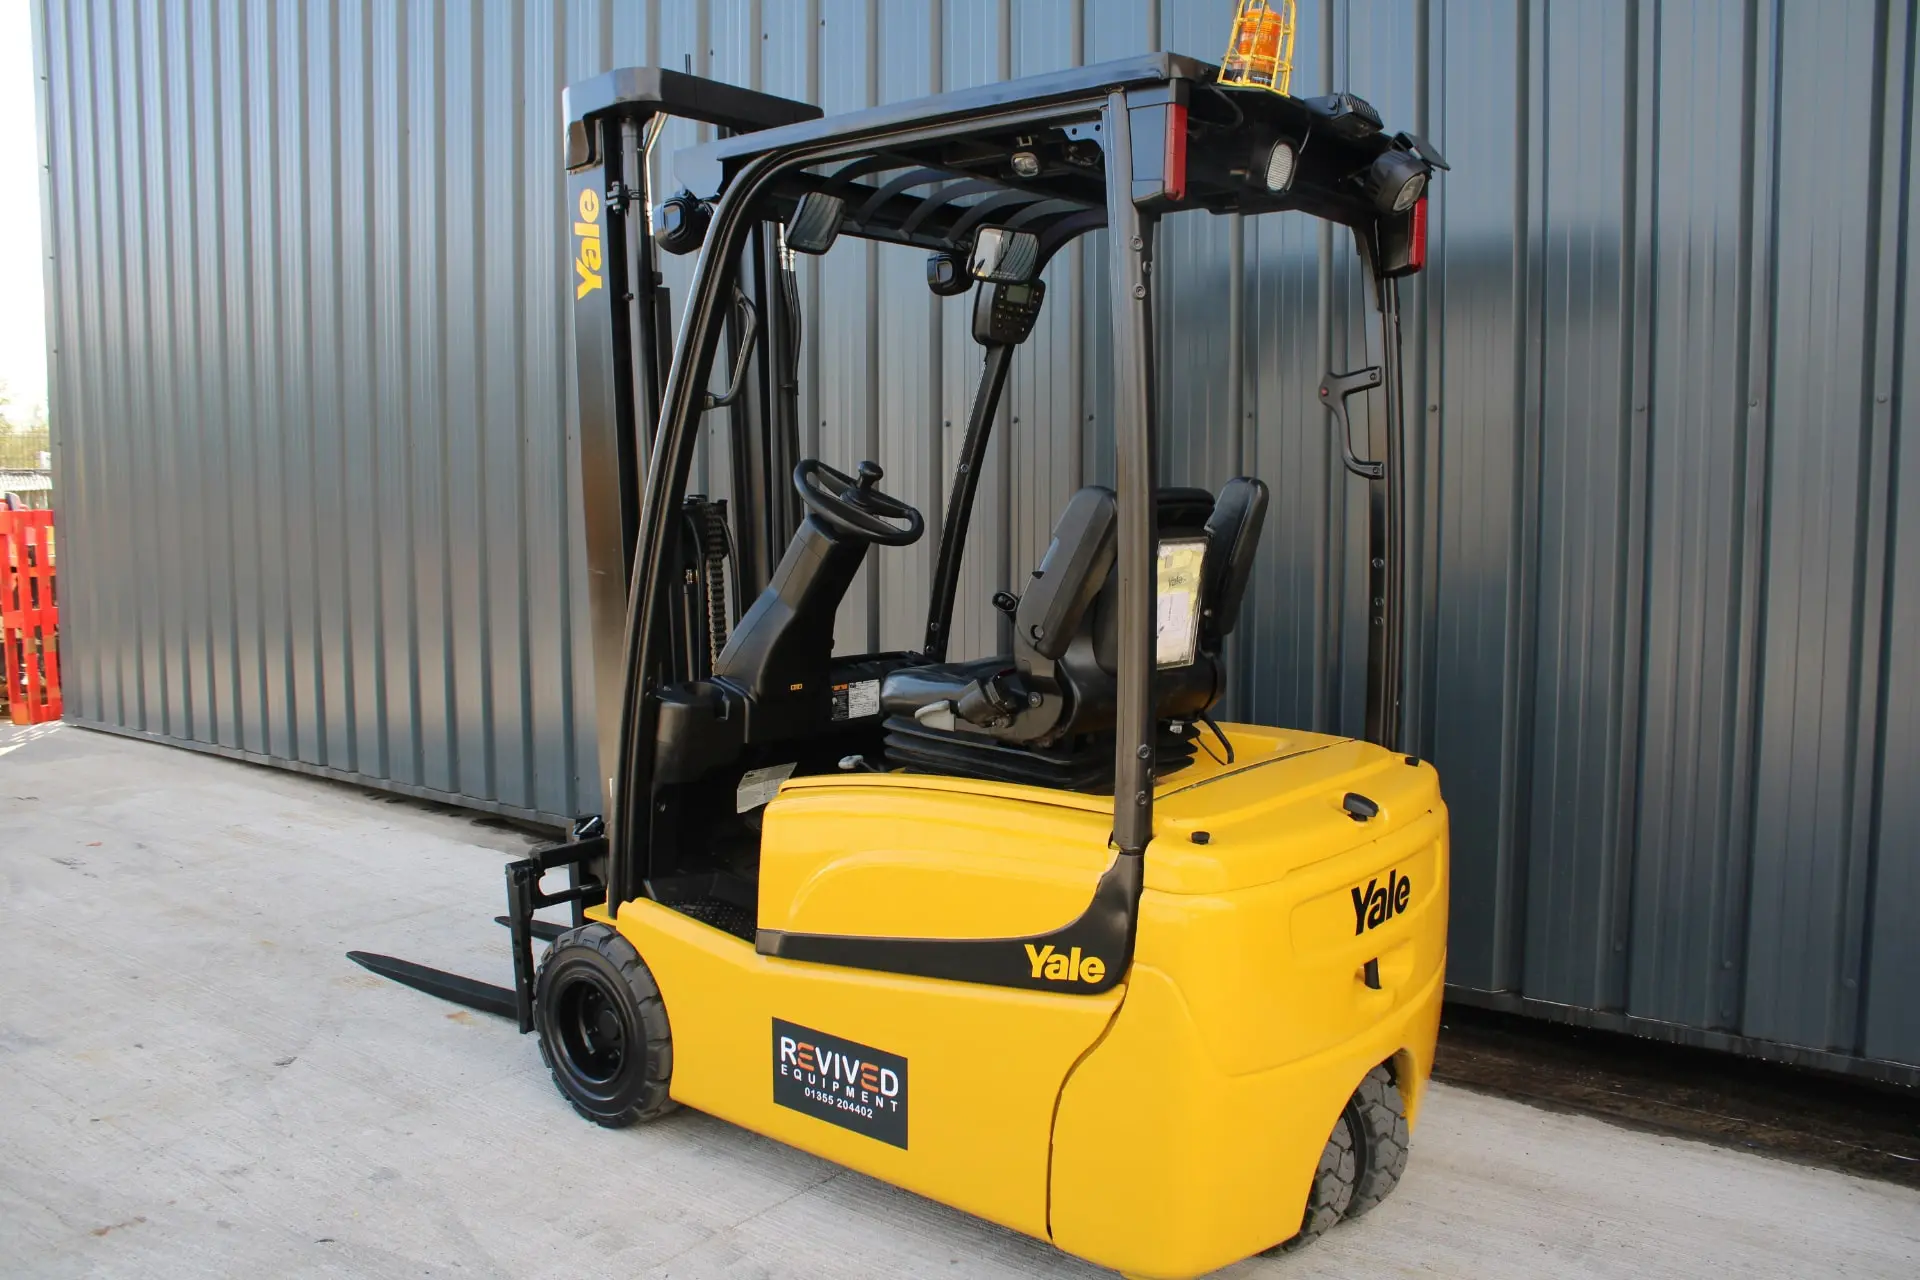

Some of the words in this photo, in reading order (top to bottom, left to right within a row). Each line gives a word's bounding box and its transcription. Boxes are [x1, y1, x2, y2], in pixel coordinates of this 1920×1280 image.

[574, 188, 602, 300] Yale
[1351, 868, 1410, 936] Yale
[1024, 943, 1106, 984] Yale
[780, 1036, 899, 1097] REVIVED
[781, 1064, 898, 1112] EQUIPMENT
[804, 1087, 834, 1105] 01355
[836, 1098, 873, 1118] 204402
